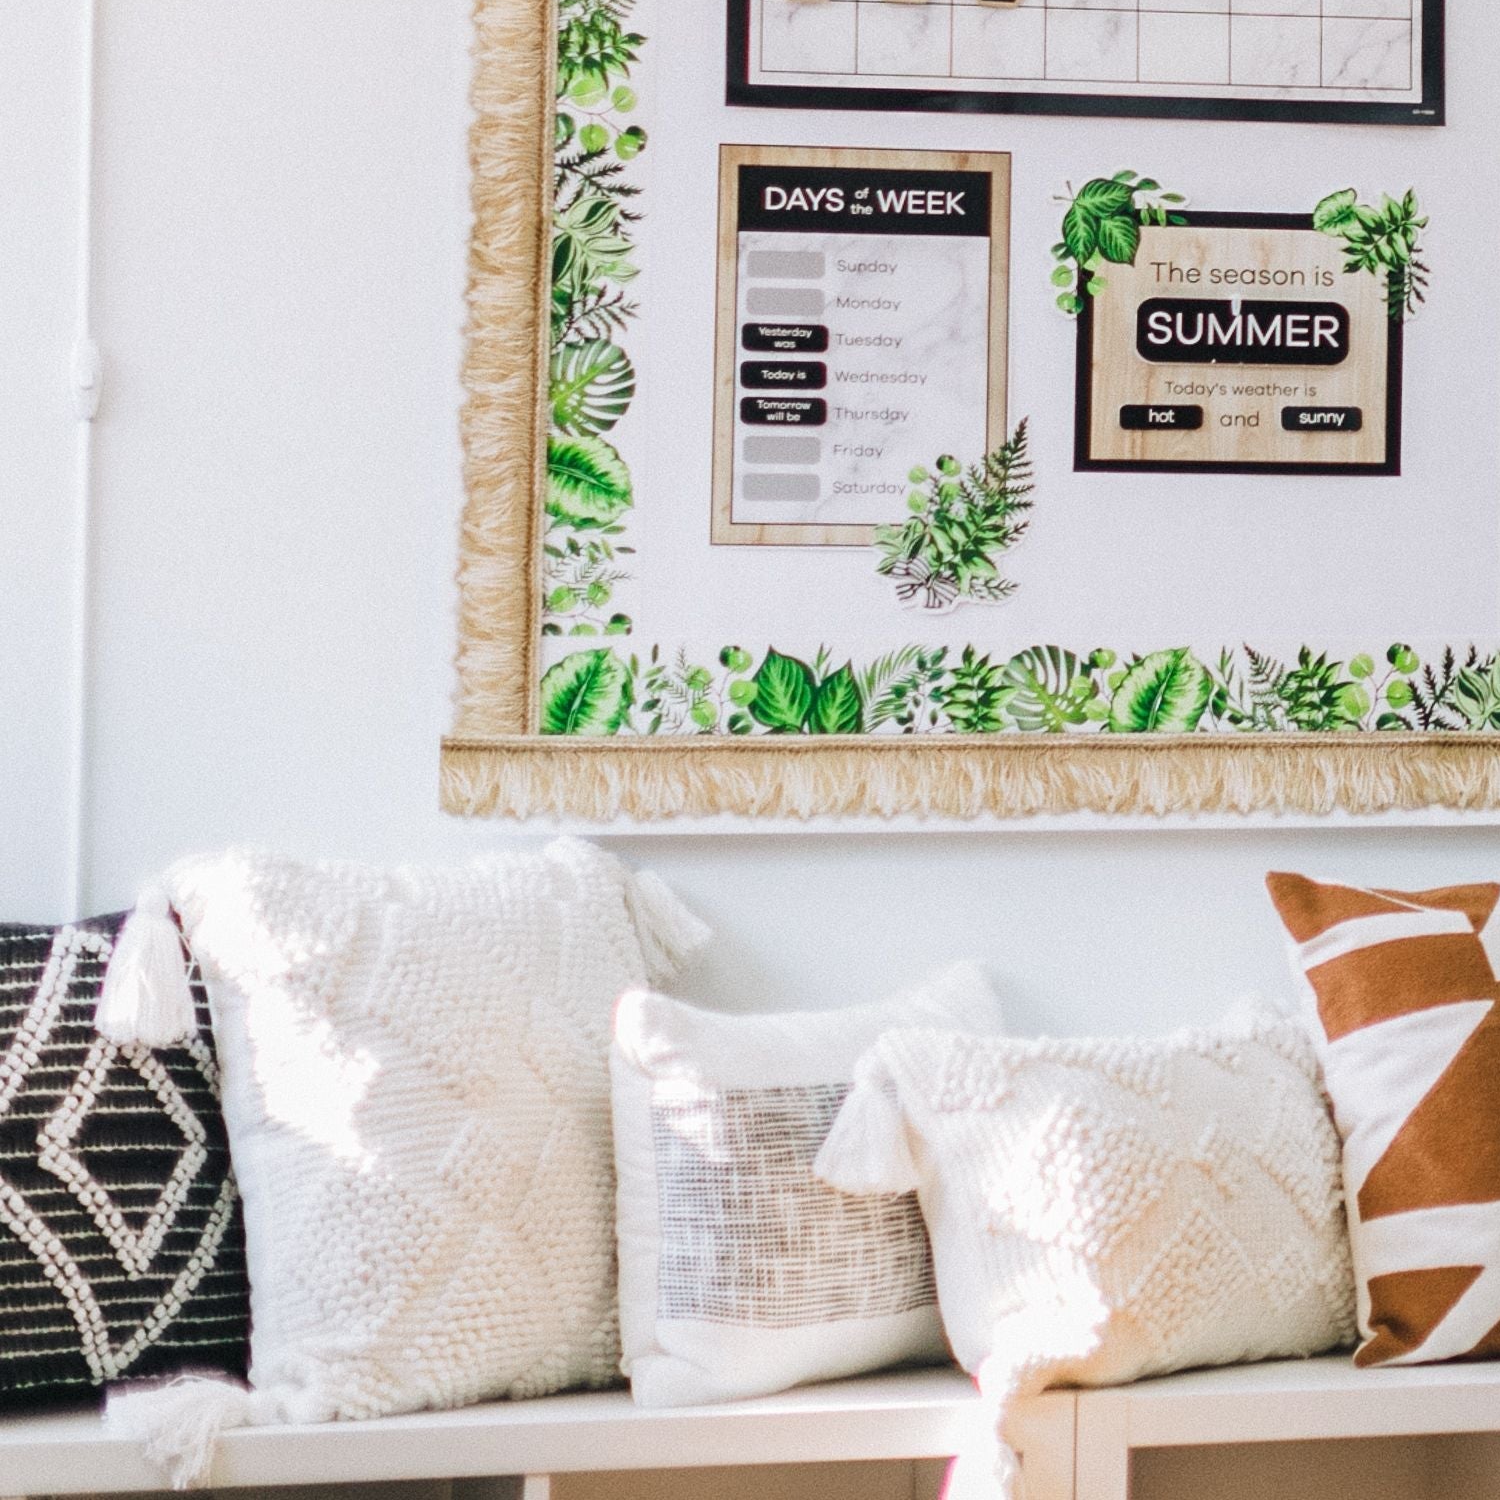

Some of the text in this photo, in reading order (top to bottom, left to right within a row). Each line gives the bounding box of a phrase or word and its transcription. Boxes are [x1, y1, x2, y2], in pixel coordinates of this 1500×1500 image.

[764, 186, 966, 216] DAYS of the WEEK
[837, 259, 897, 275] Sunday
[1150, 262, 1335, 286] The season is
[836, 297, 901, 312] Monday
[758, 327, 813, 338] Yesterday
[1147, 311, 1339, 348] SUMMER
[774, 340, 796, 349] was
[836, 334, 902, 349] Tuesday
[761, 370, 806, 381] Today is
[835, 371, 927, 385] Wednesday
[1165, 381, 1317, 397] Today's weather is
[757, 400, 811, 410] Tomorrow
[767, 413, 784, 421] will
[834, 408, 910, 422] Thursday
[1148, 409, 1345, 427] hot and sunny
[833, 445, 884, 458] Friday
[833, 481, 906, 495] Saturday
